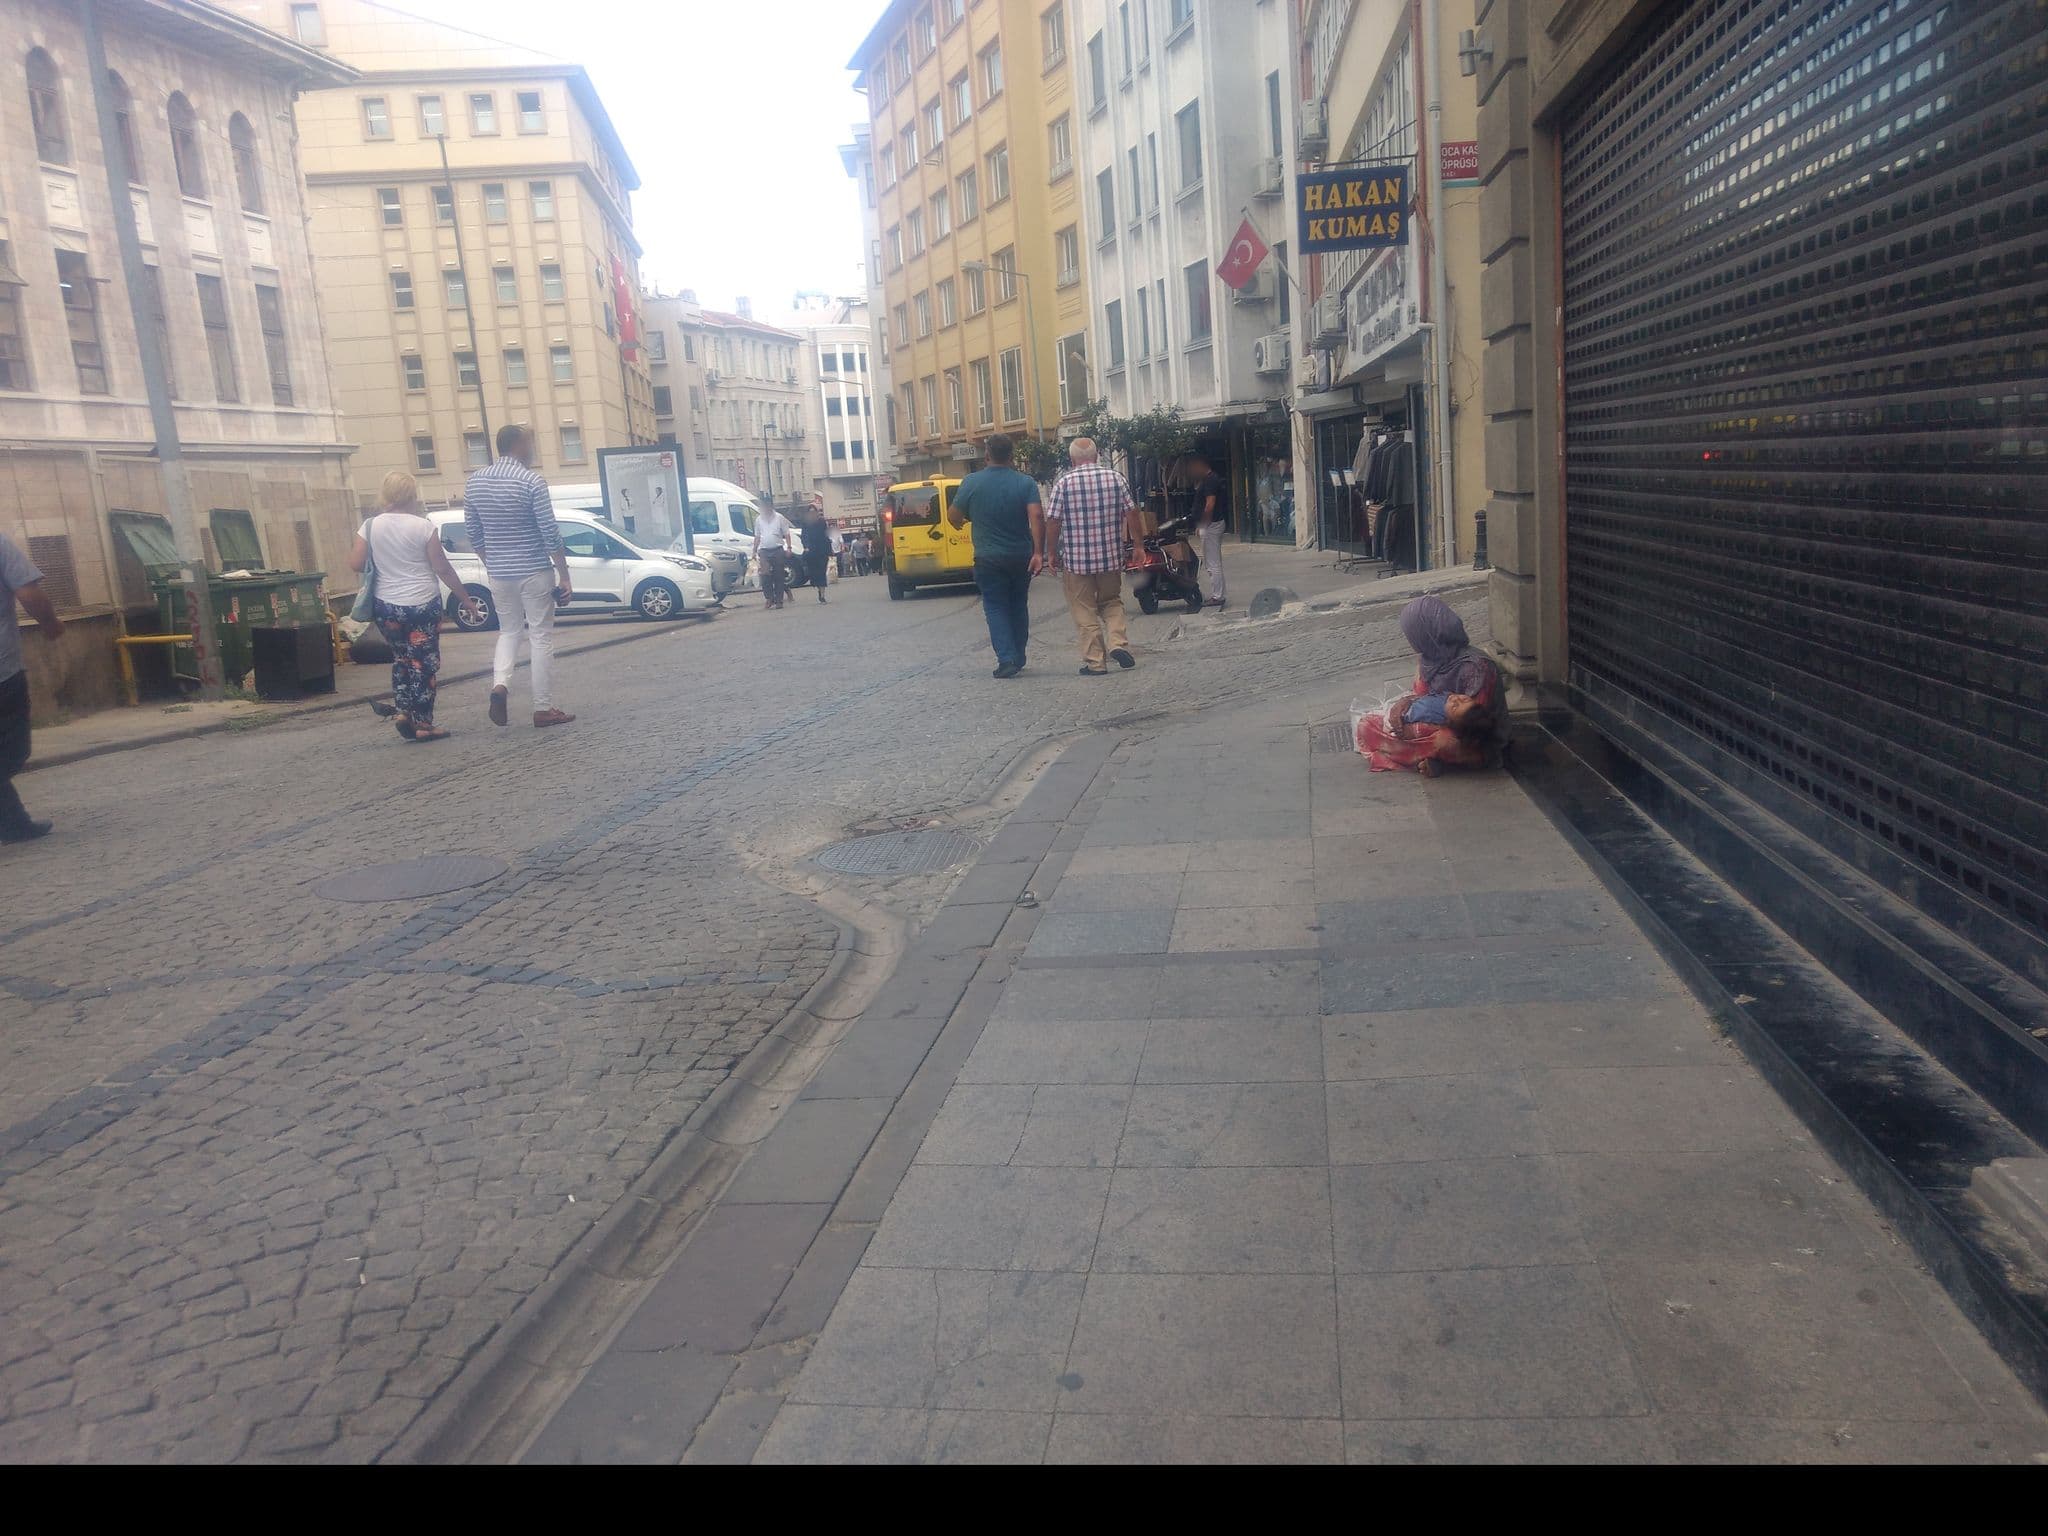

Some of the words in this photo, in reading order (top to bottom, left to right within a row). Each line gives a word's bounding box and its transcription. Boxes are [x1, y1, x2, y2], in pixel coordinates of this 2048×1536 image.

[1441, 147, 1460, 157] OCA
[1441, 157, 1478, 169] ÖPRÜSÜ
[1304, 178, 1401, 211] HAKAN
[1308, 212, 1400, 240] KUMAŞ
[736, 460, 745, 489] HOTE
